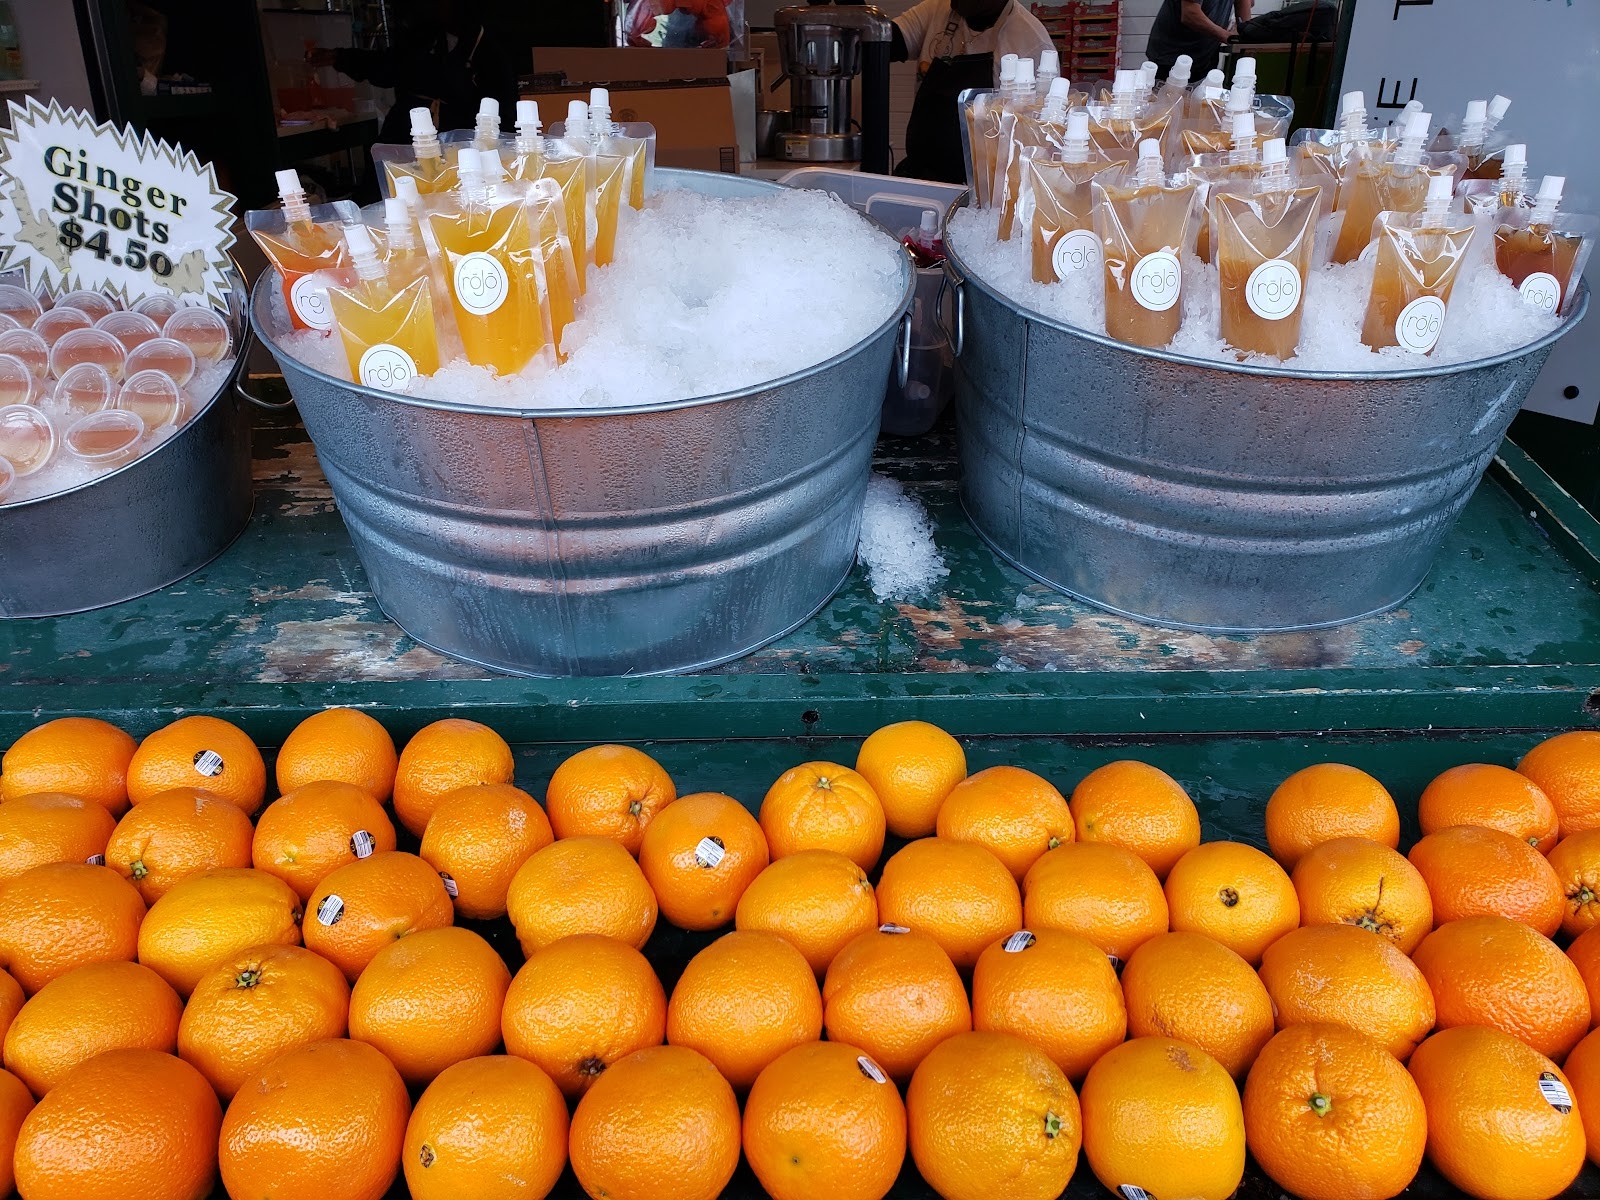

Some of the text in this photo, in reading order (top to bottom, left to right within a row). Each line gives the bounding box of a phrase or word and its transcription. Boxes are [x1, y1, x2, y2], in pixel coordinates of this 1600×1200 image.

[44, 146, 188, 217] Ginger
[52, 182, 169, 244] Shots
[58, 216, 175, 278] $4.50
